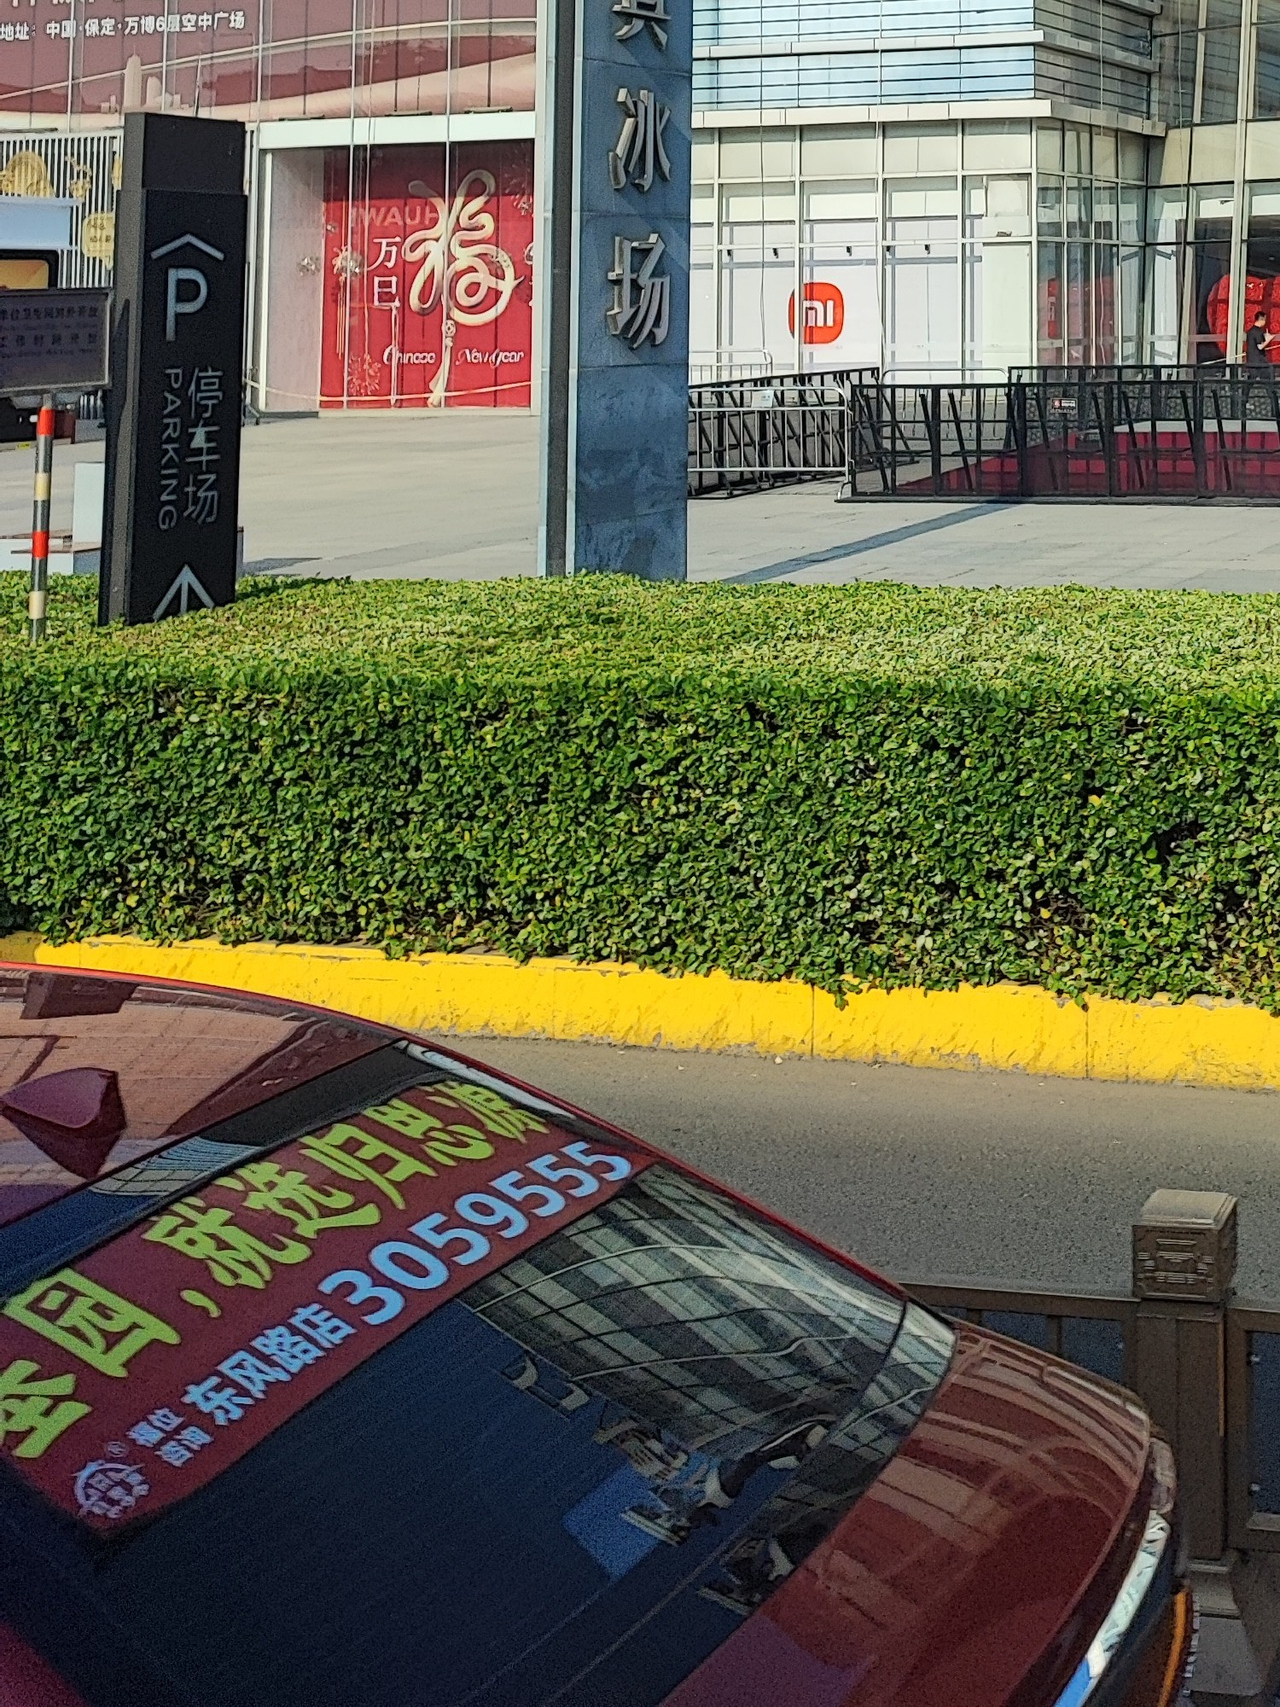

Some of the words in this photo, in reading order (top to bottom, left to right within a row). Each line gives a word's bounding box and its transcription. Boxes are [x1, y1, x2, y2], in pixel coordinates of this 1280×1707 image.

[165, 267, 208, 342] P
[157, 368, 183, 531] PARKING
[183, 366, 224, 524] 停车场
[181, 1302, 357, 1426] 东风路店
[317, 1140, 634, 1327] 3059555
